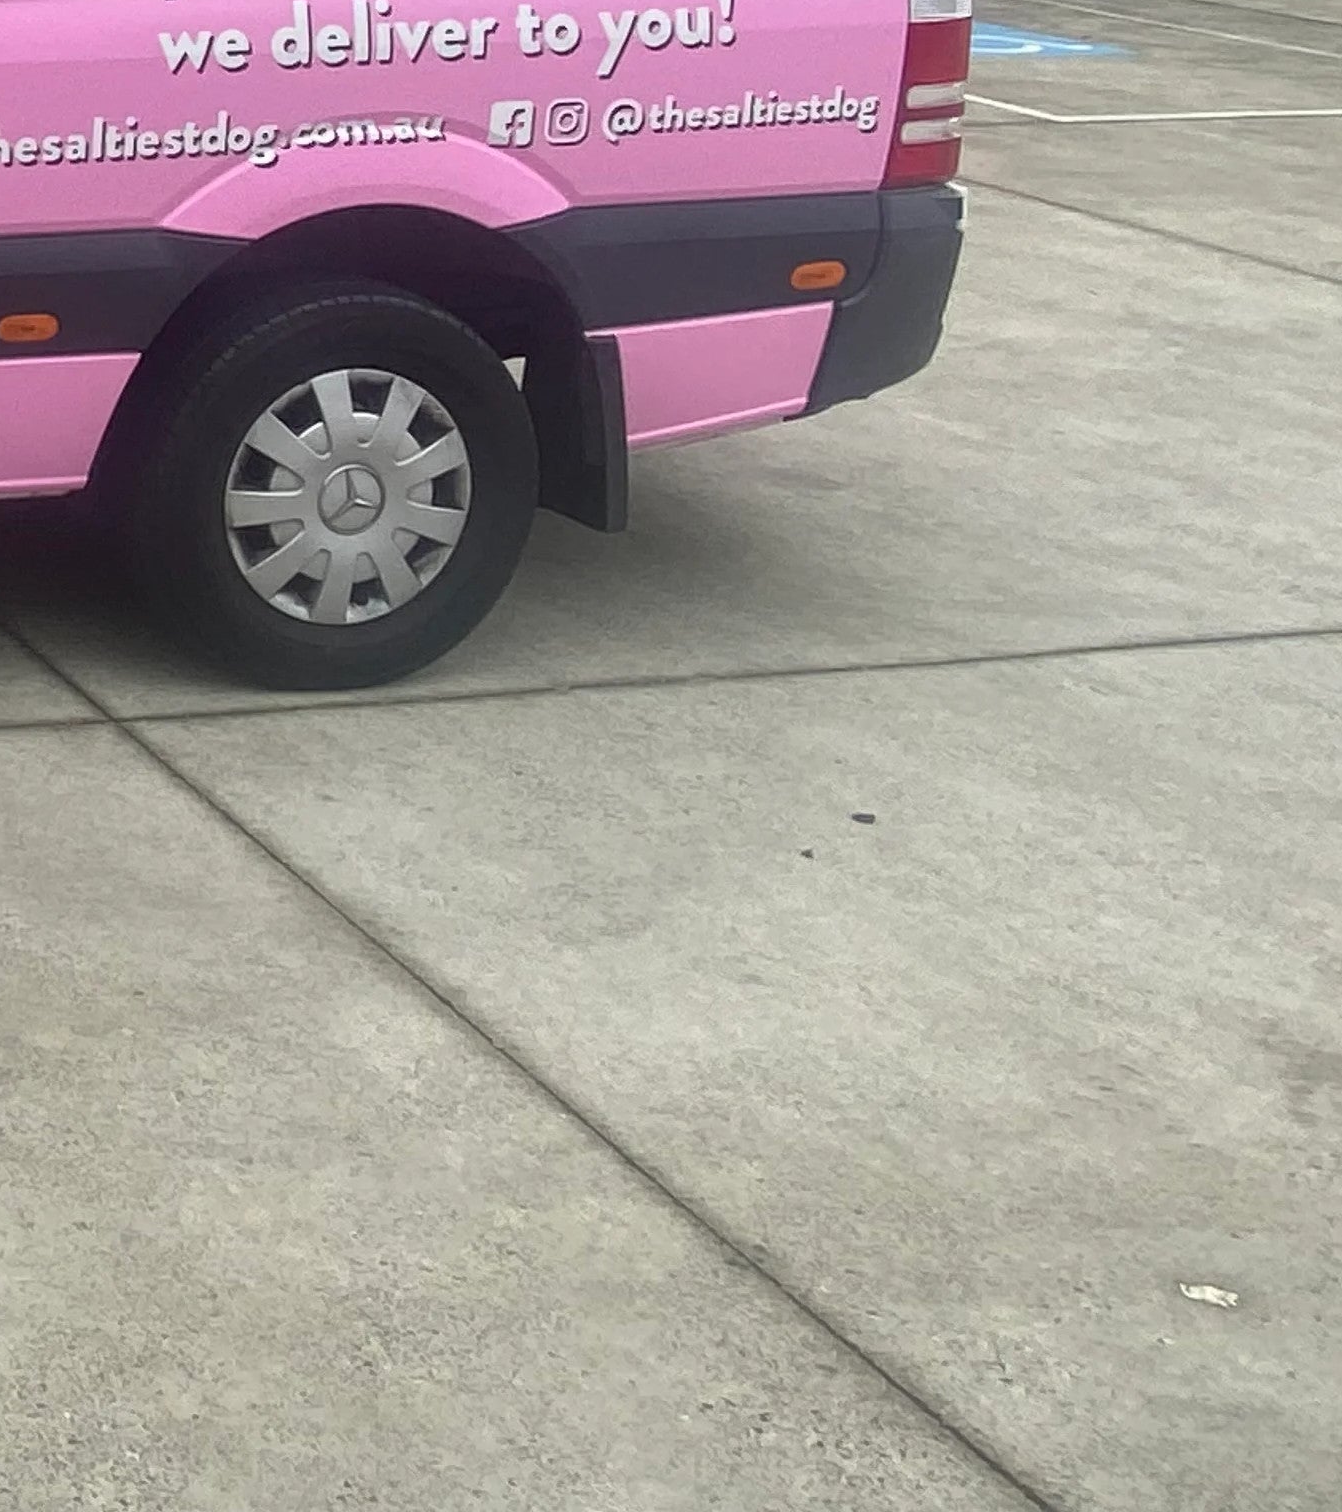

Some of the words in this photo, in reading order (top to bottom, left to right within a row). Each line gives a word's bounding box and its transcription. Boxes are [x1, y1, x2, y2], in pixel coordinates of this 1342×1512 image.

[157, 26, 251, 73] we
[271, 0, 497, 67] deliver
[517, 4, 582, 56] to
[601, 87, 880, 144] @thesaltiestdog
